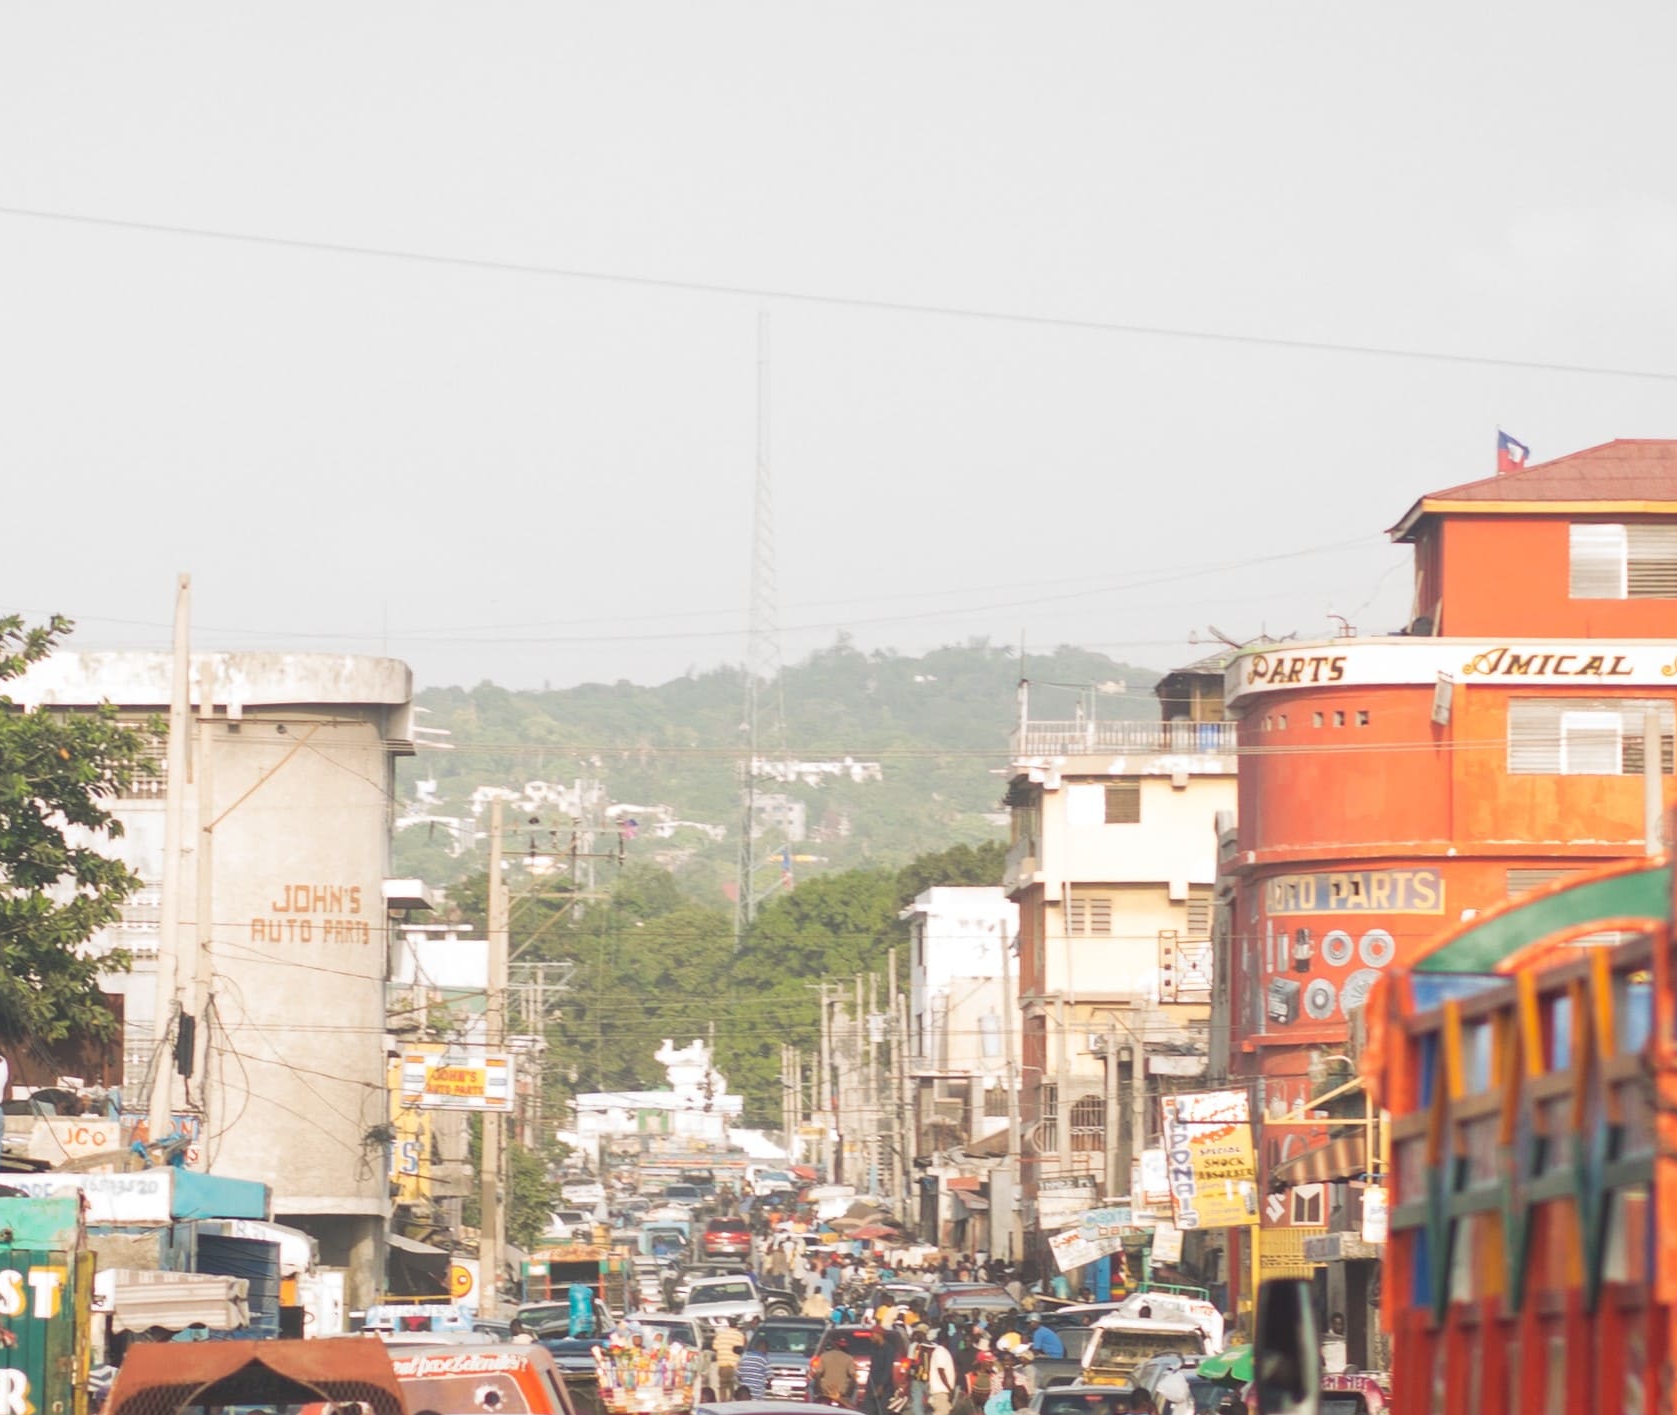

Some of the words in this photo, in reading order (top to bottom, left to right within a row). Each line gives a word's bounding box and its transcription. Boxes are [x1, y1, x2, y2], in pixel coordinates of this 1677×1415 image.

[1248, 655, 1347, 686] PARTS
[1463, 648, 1634, 679] AMICAL
[273, 885, 361, 913] JOHN'S
[1329, 871, 1437, 909] PARTS
[251, 918, 312, 943] AUTO
[324, 919, 370, 944] PARTS
[1197, 1168, 1253, 1180] ABSORBER
[1203, 1157, 1245, 1169] SHOCK
